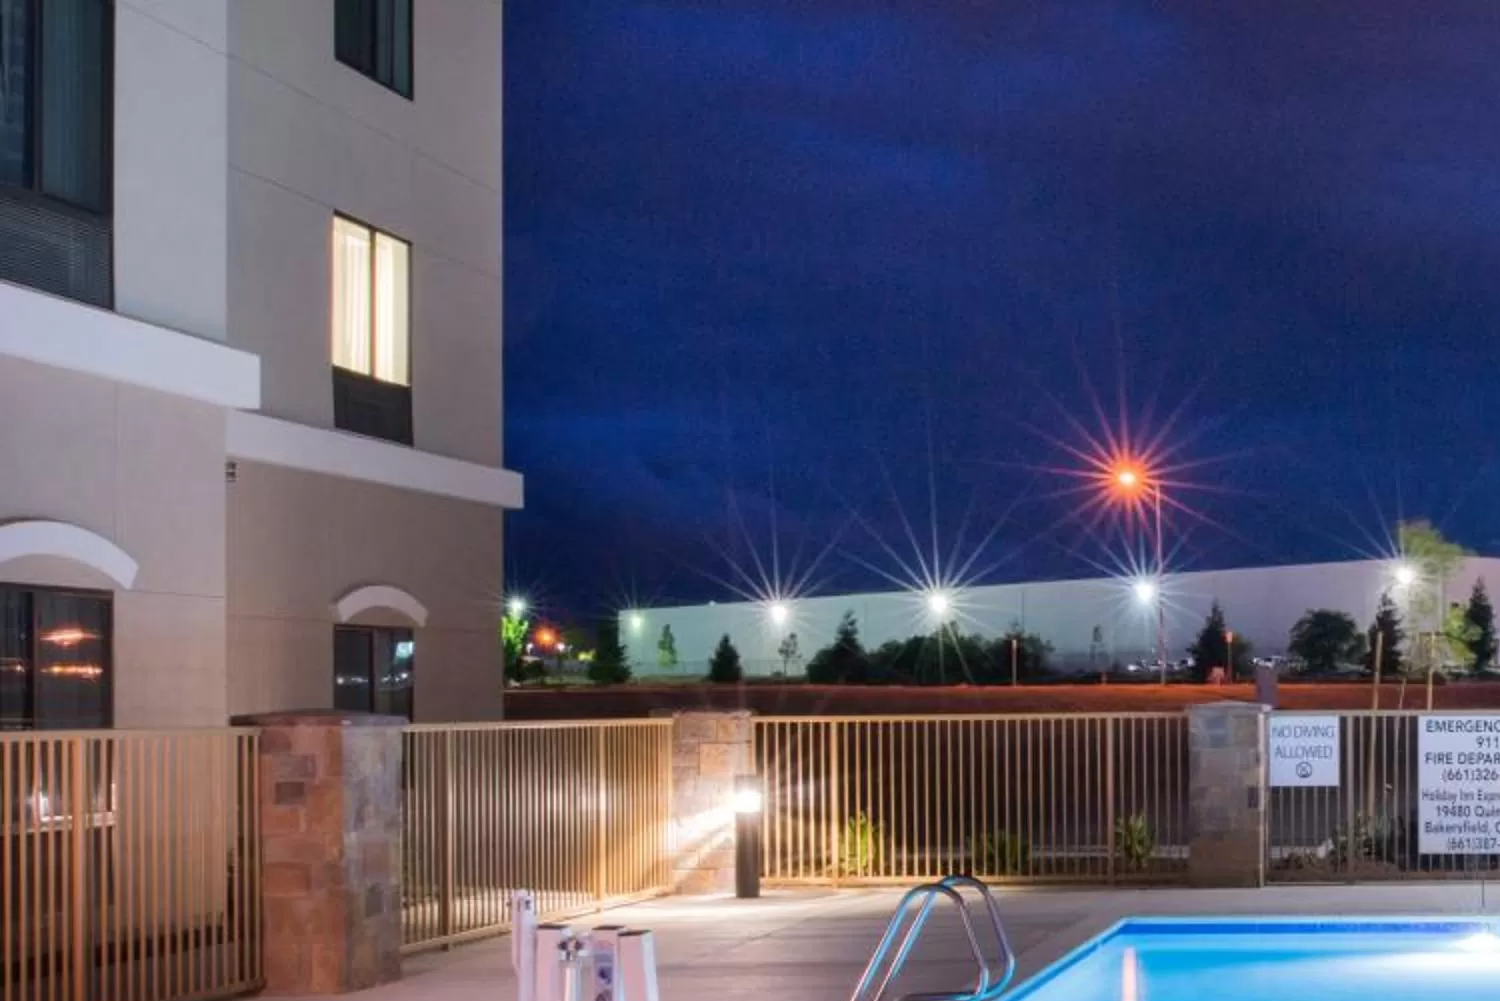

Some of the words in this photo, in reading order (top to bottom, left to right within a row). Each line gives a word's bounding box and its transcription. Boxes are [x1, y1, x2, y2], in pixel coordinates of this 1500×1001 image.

[1271, 725, 1292, 738] NO
[1294, 725, 1336, 738] DIVING
[1476, 735, 1499, 748] 911
[1275, 745, 1333, 758] ALLOWED
[1425, 751, 1453, 765] FIRE
[1422, 788, 1458, 805] Holiday
[1460, 788, 1475, 801] Inn
[1424, 820, 1491, 835] Bakersfield,
